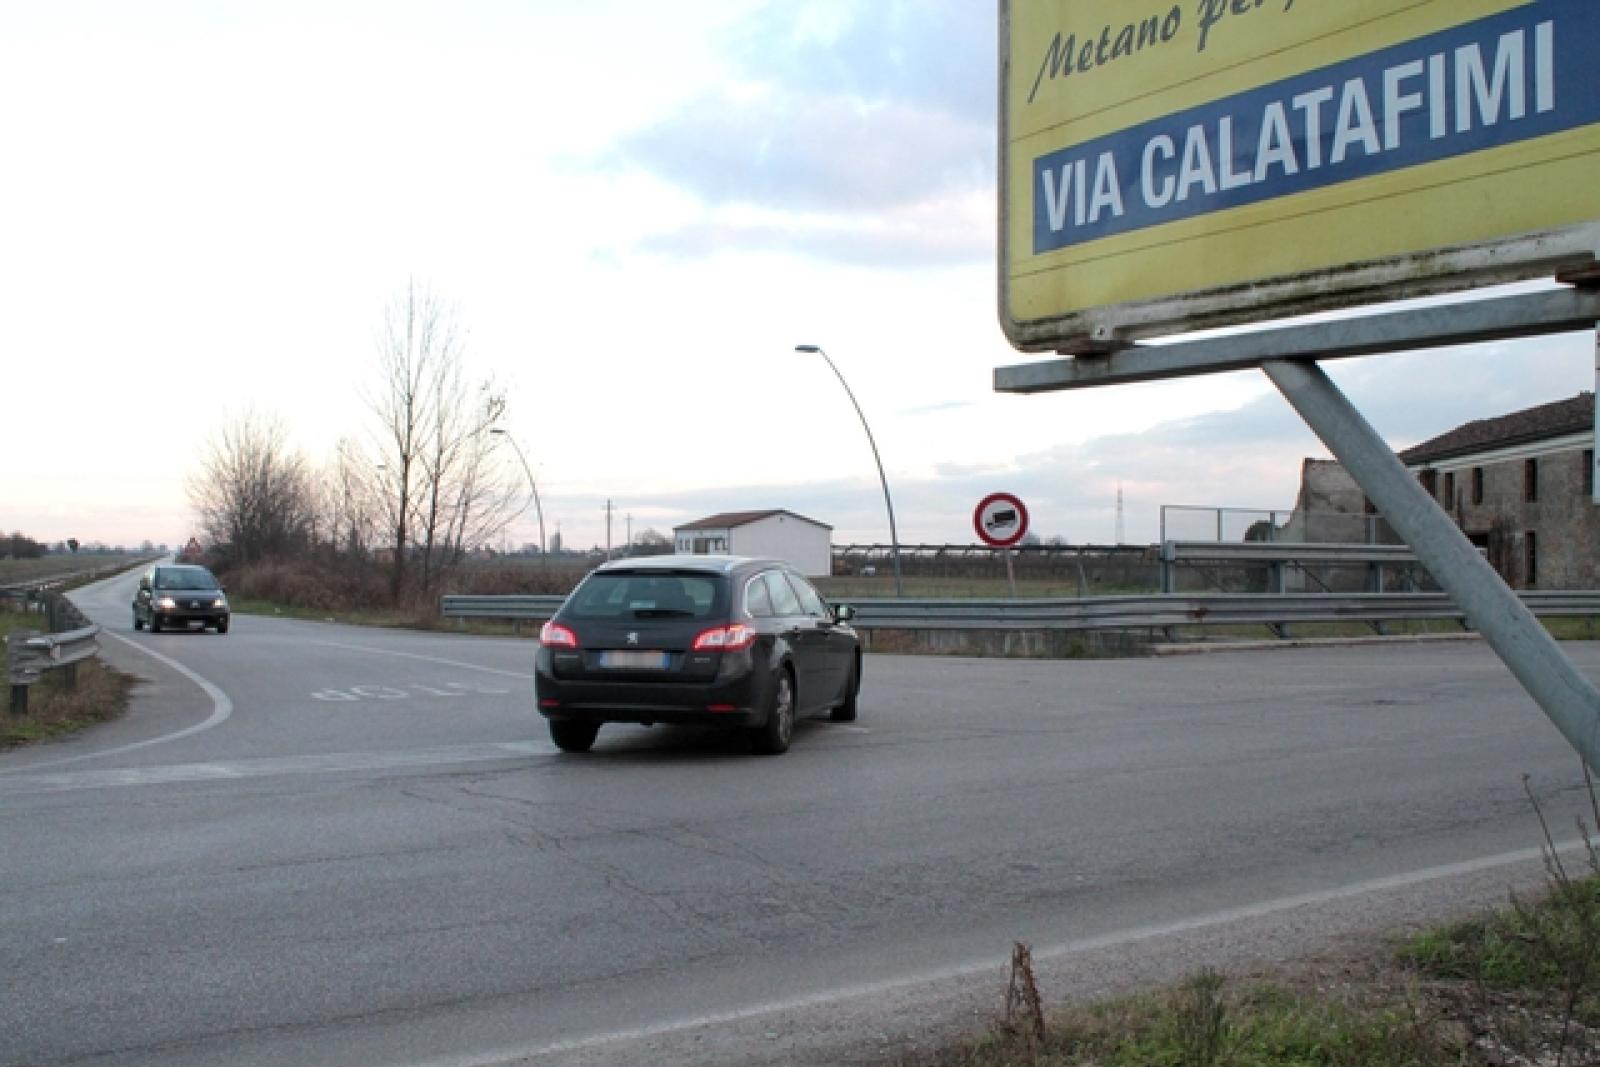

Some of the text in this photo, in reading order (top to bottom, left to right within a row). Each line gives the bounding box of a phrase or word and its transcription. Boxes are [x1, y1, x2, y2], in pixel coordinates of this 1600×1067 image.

[1028, 5, 1181, 104] Metano
[1042, 20, 1554, 231] VIA CALATAFIMI
